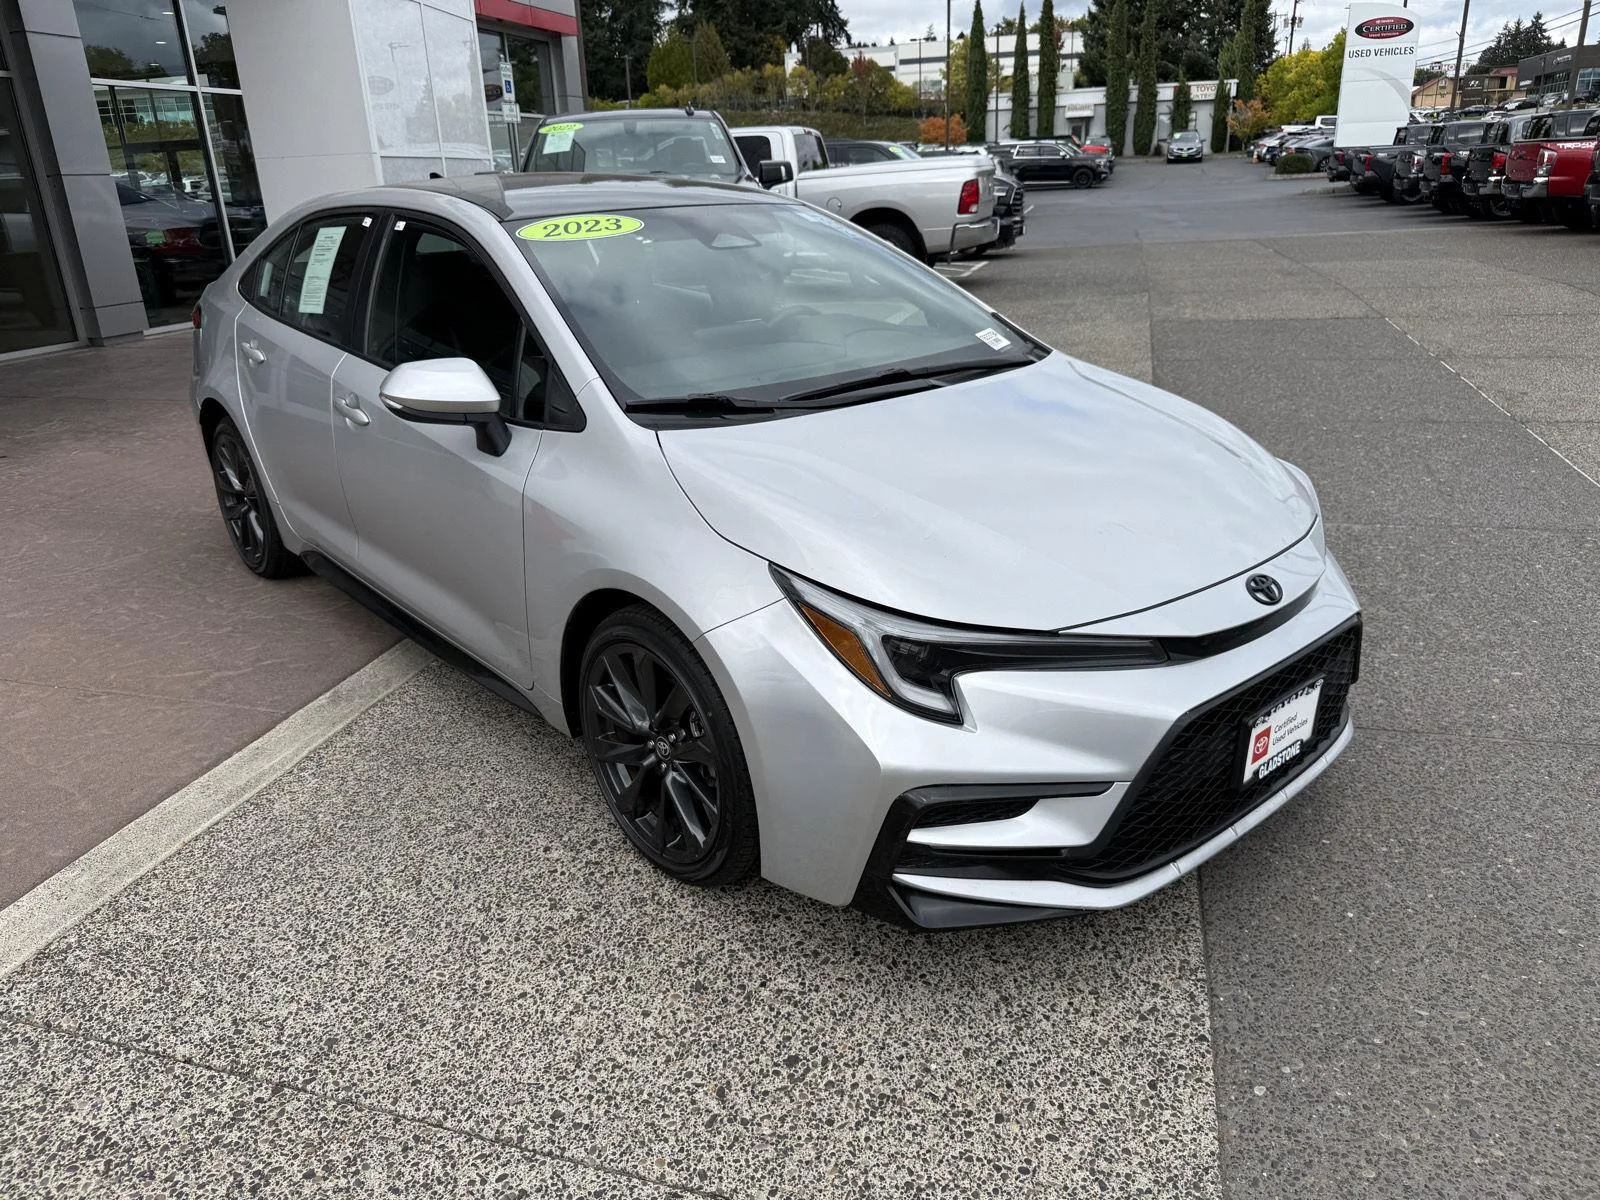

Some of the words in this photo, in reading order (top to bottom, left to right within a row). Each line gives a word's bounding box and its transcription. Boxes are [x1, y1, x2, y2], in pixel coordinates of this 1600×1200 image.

[1362, 23, 1407, 33] CERTIFIED
[1348, 48, 1372, 58] USED
[1374, 46, 1415, 57] VEHICLES
[1556, 142, 1581, 150] TRD
[542, 217, 623, 238] 2023
[1272, 731, 1287, 746] Used
[1287, 718, 1309, 738] Vehicles
[1273, 712, 1298, 734] Certified
[1258, 741, 1301, 780] GLADSTONE
